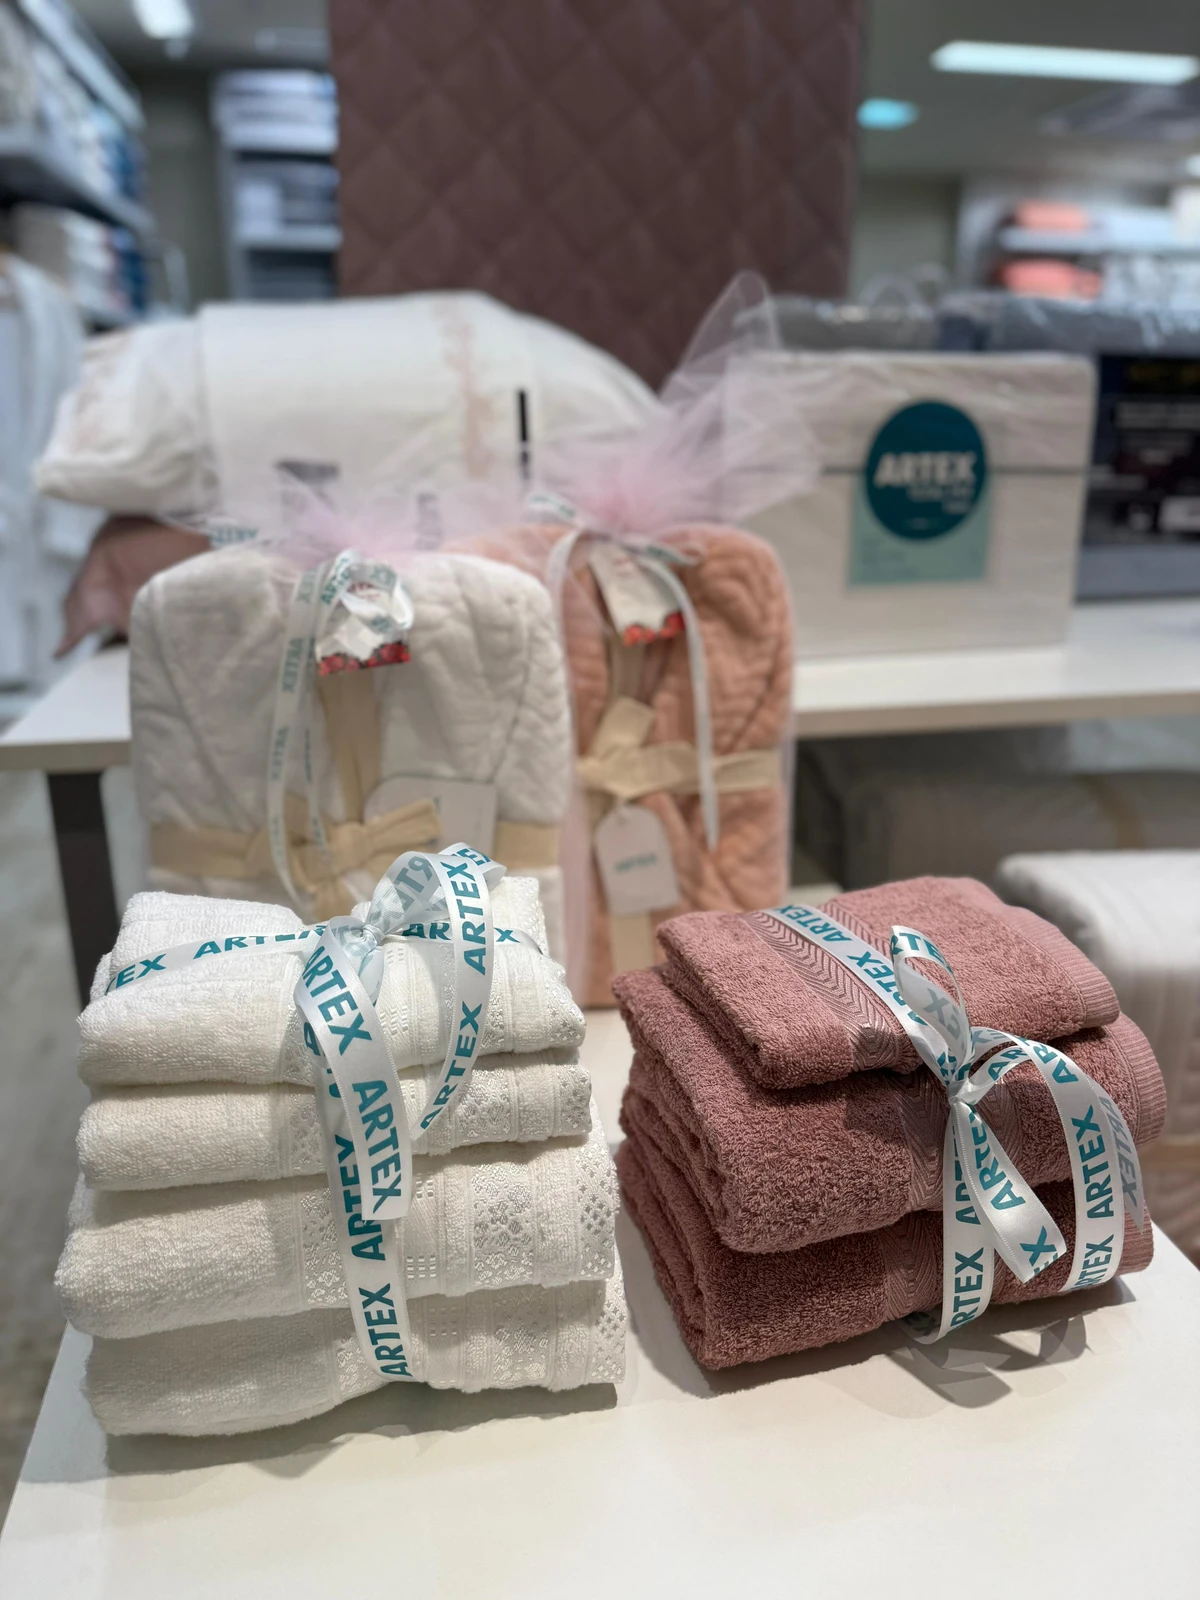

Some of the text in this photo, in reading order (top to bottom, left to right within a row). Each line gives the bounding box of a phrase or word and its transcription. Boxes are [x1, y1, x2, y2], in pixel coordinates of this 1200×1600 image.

[872, 452, 977, 488] ARTEX
[440, 861, 487, 976] ARTEX
[773, 904, 853, 943] ARTEX
[302, 945, 373, 1056] ARTEX
[419, 1000, 483, 1130] ARTEX
[351, 1079, 402, 1214] ARTEX
[1071, 1104, 1115, 1219] ARTEX
[950, 1246, 985, 1330] RTEX
[1069, 1234, 1115, 1292] RTEX
[358, 1282, 413, 1378] ARTEX
